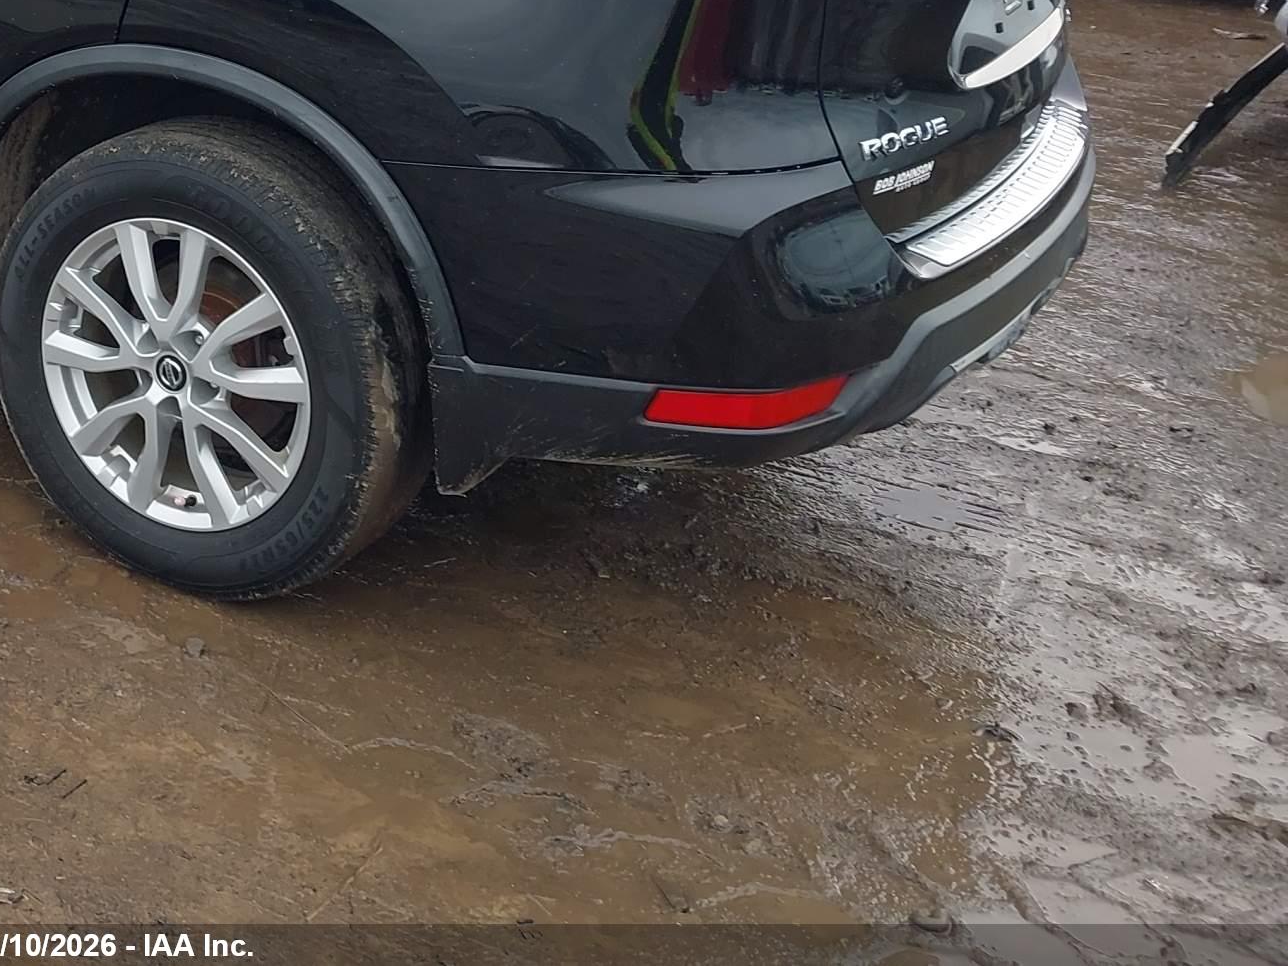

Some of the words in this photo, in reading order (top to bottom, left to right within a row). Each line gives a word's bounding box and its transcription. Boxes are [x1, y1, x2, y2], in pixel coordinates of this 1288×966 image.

[858, 116, 950, 162] ROGUE
[874, 175, 896, 192] BOB
[894, 160, 935, 187] JOHNSON
